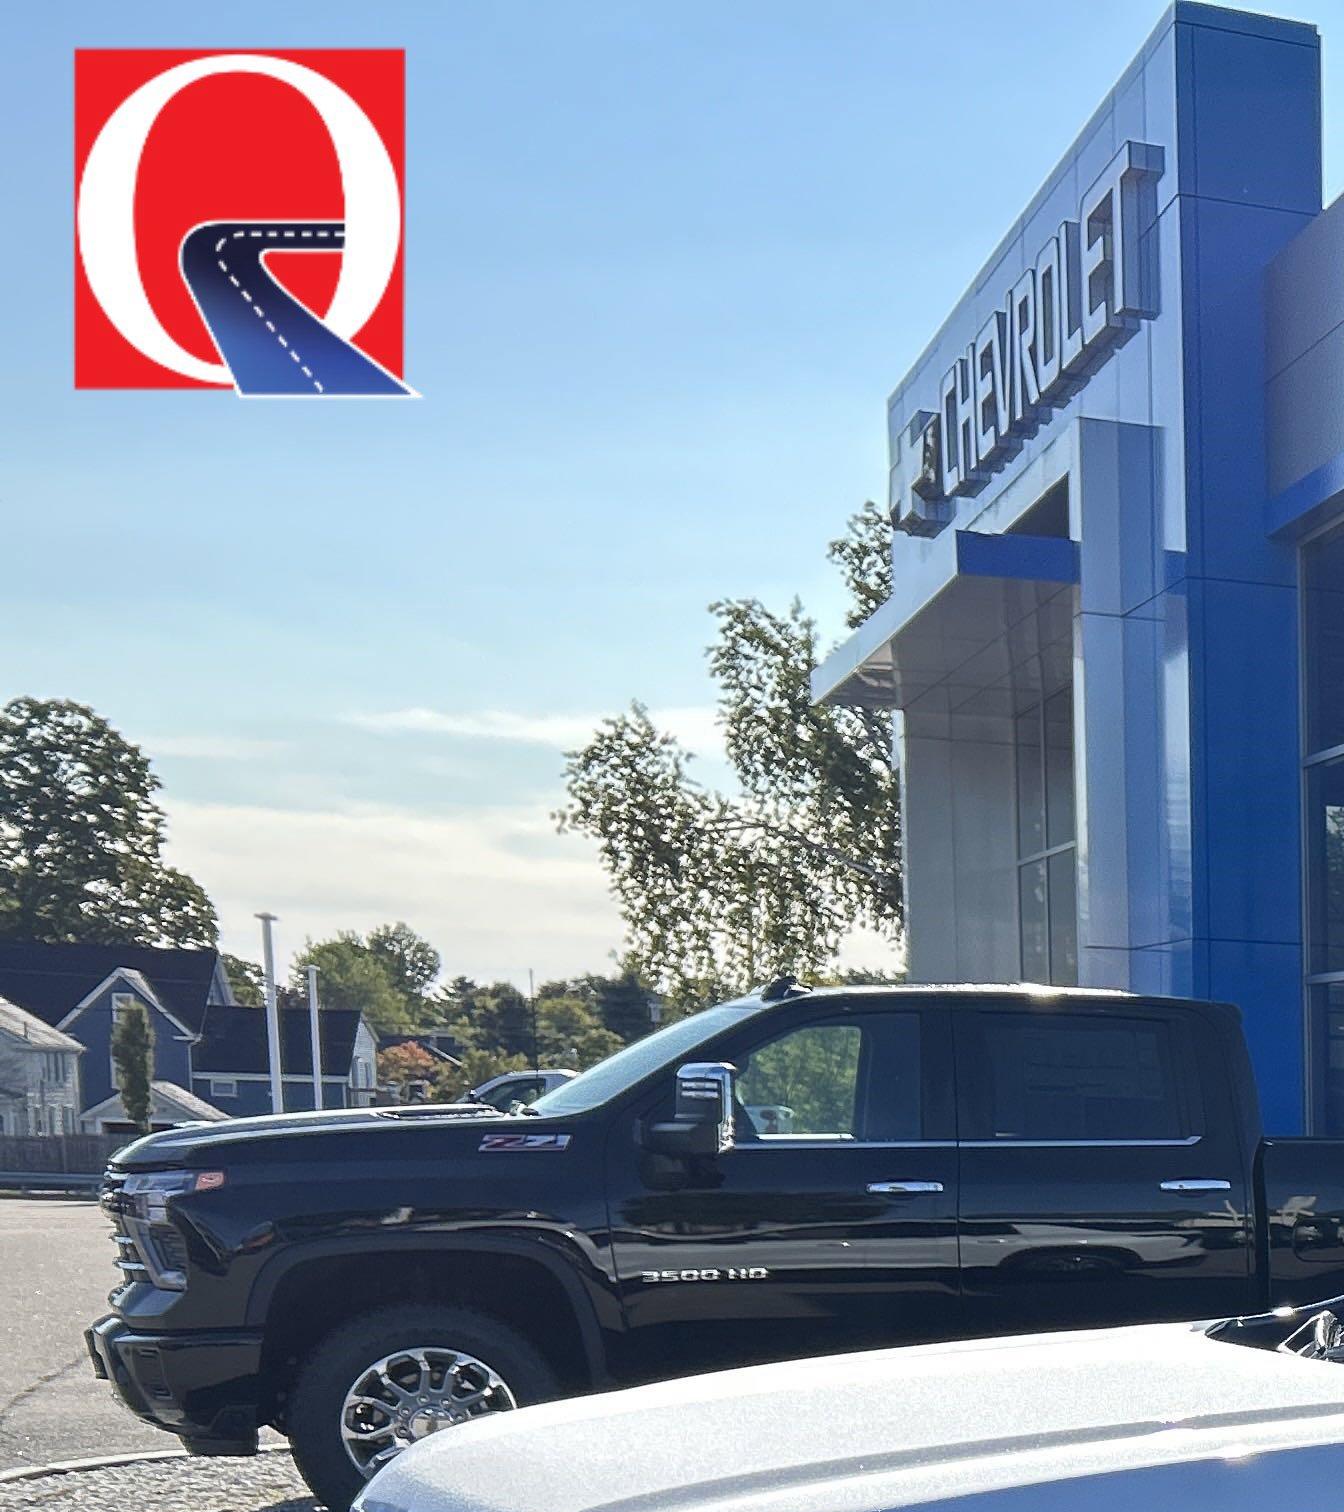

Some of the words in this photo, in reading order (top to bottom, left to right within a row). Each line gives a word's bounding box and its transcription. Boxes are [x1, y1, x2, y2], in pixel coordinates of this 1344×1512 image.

[938, 140, 1166, 499] CHEVROLET
[479, 1134, 574, 1151] Z71
[641, 1268, 720, 1283] 3500
[728, 1266, 769, 1281] HD
